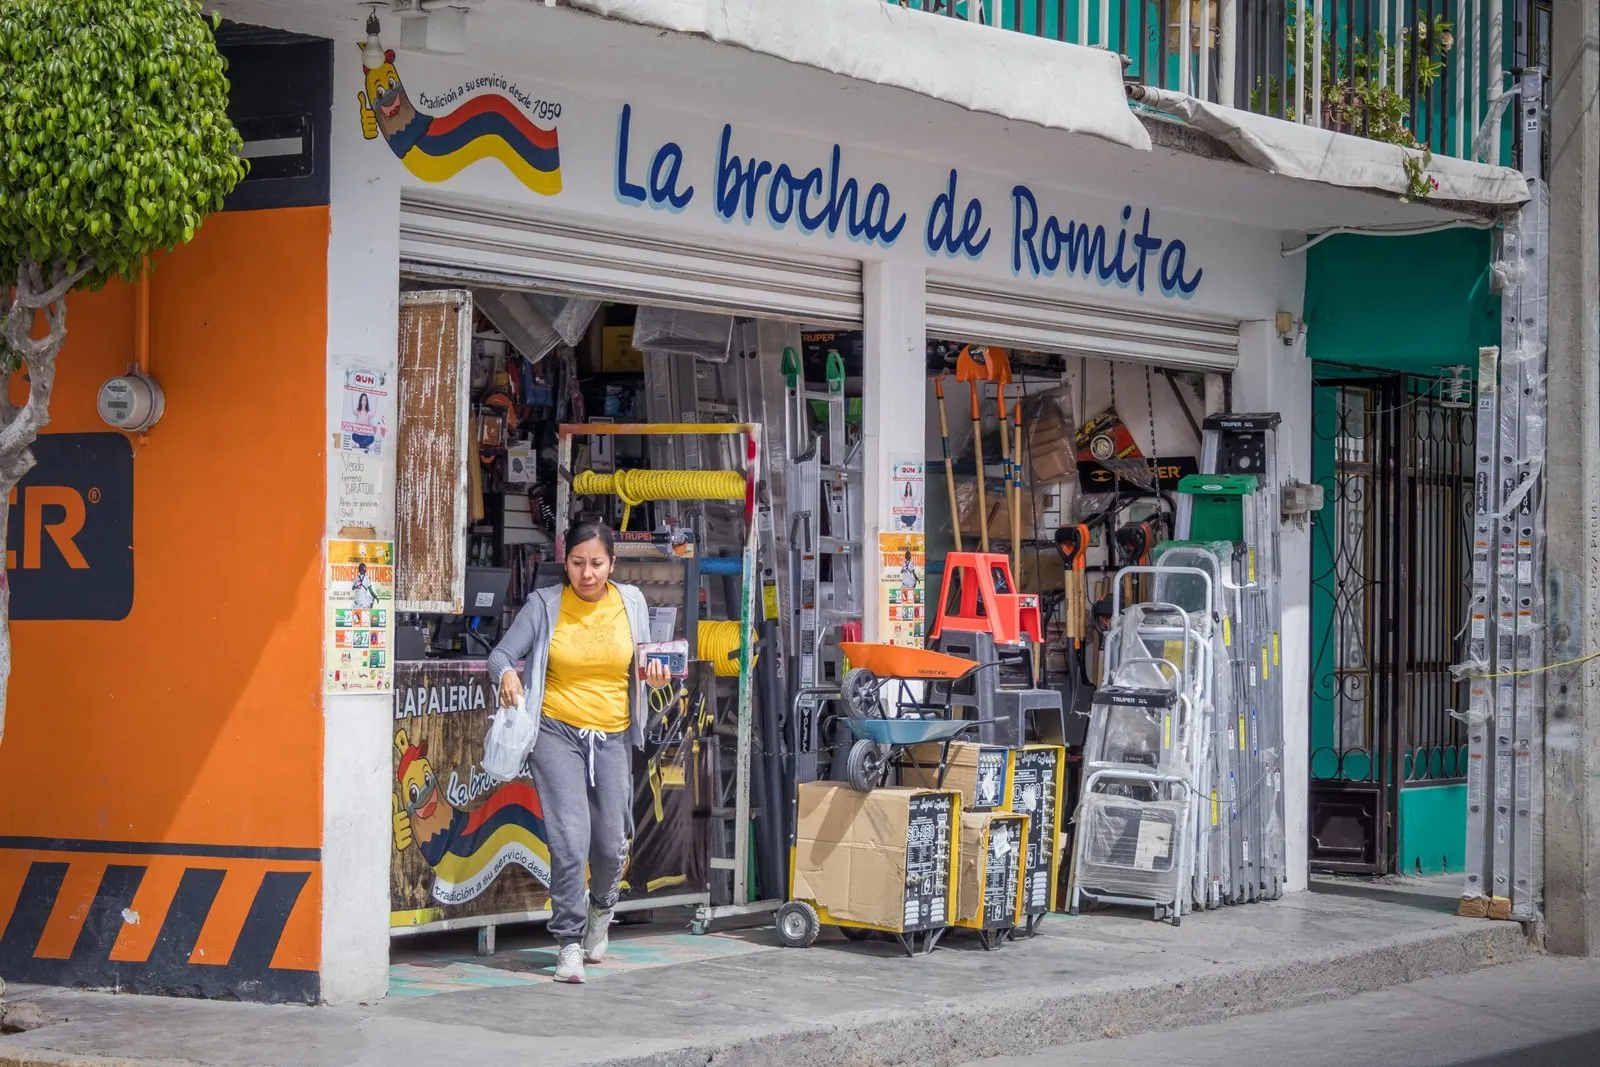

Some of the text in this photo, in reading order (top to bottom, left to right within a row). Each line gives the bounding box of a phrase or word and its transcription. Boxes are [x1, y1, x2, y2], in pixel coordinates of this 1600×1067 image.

[458, 86, 464, 96] a
[465, 80, 475, 92] su
[475, 73, 507, 90] servicio
[509, 83, 531, 109] desde
[615, 103, 1203, 296] La brocha de Romita
[1115, 465, 1180, 481] TPER
[620, 532, 652, 541] TRUPE
[393, 677, 486, 719] LAPALERÍA
[434, 885, 475, 901] tradición
[475, 882, 482, 892] a
[494, 848, 527, 874] servicio
